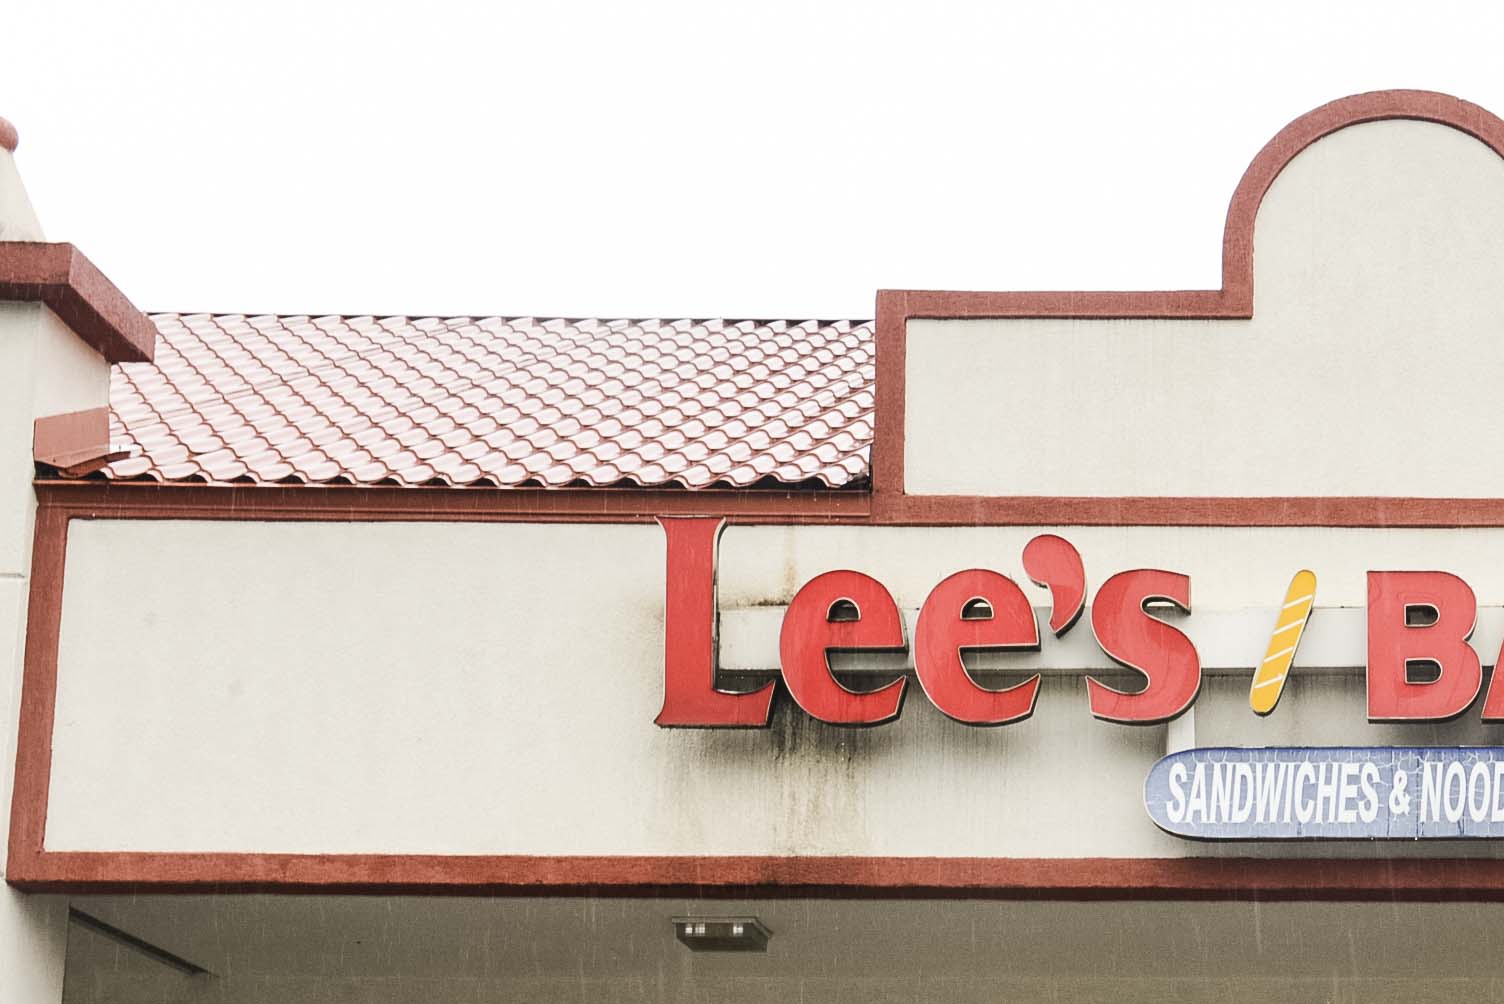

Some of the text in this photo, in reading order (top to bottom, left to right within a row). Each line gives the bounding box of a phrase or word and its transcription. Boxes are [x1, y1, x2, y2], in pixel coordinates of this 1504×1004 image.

[652, 516, 1202, 727] Lee's
[1165, 761, 1380, 824] SANDWICHES
[1388, 768, 1411, 816] &
